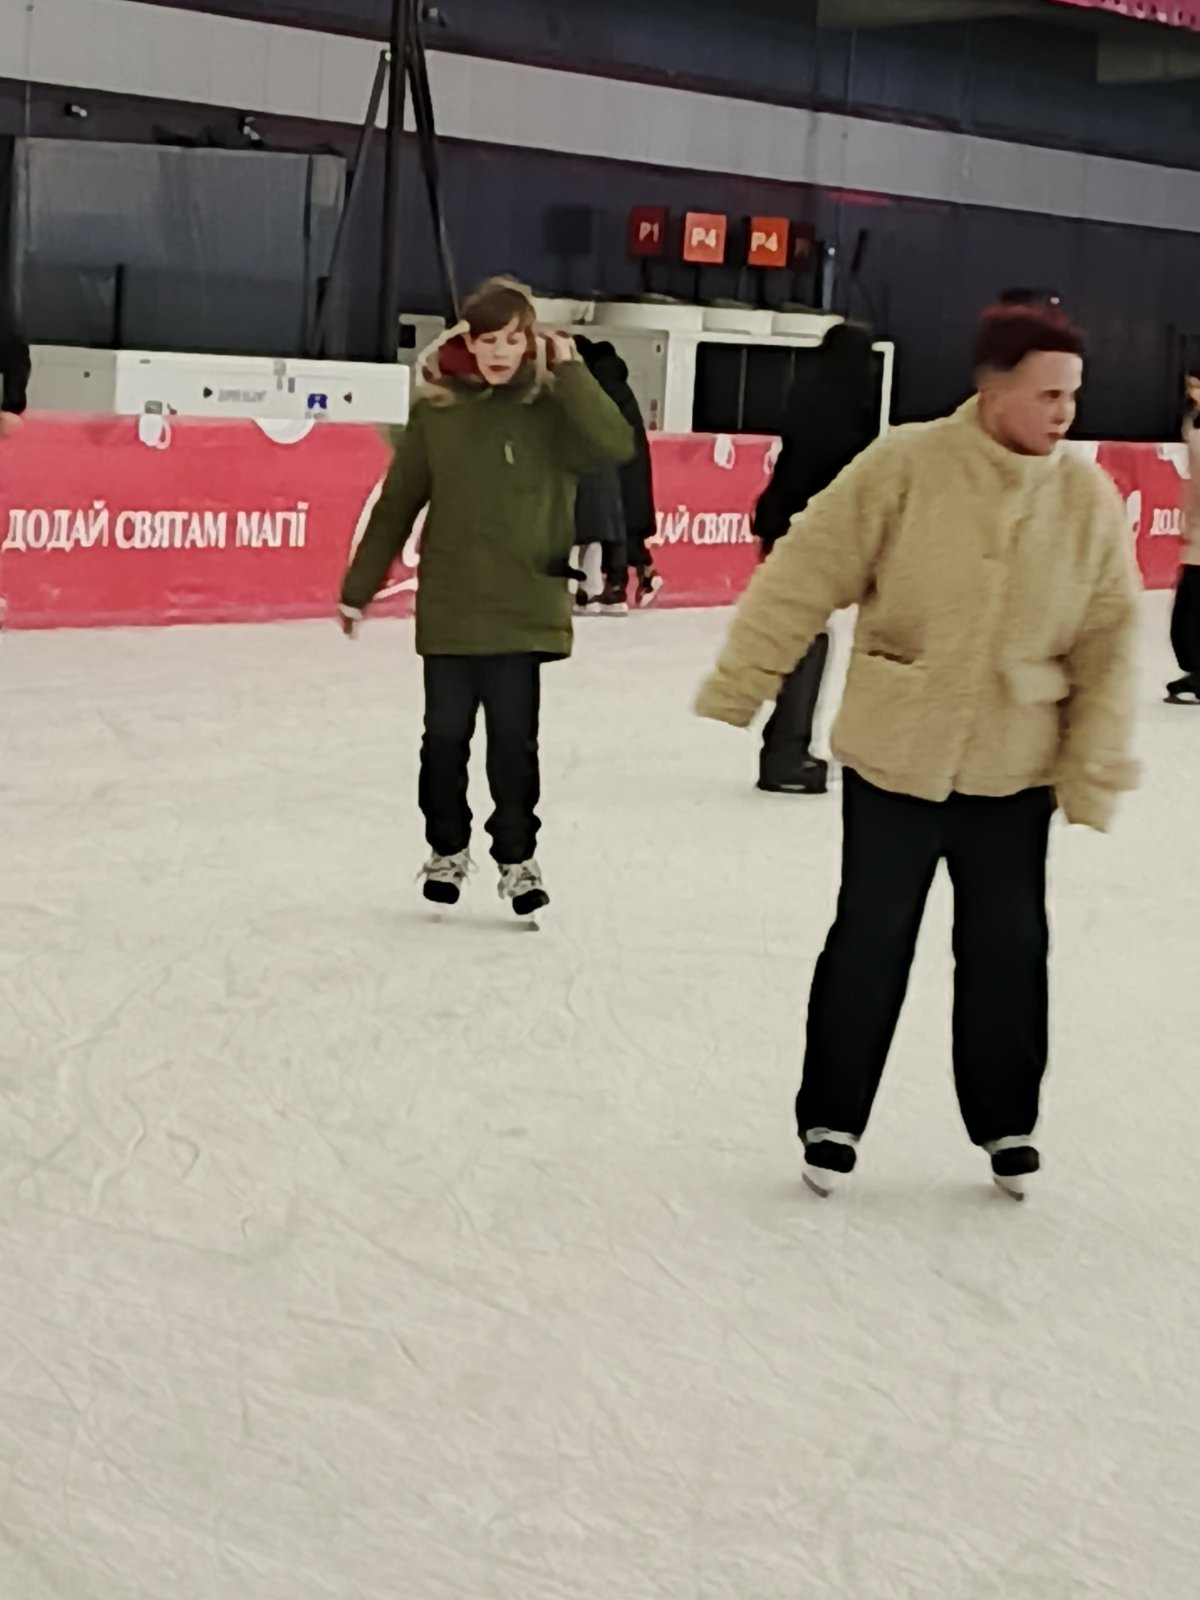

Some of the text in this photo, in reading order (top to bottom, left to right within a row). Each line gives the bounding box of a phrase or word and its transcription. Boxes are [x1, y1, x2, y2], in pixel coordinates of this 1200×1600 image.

[639, 221, 659, 242] P1
[691, 227, 717, 248] P4
[751, 231, 778, 252] P4
[3, 501, 309, 551] ДОДАЙ СВЯТАМ МАГІЇ
[692, 512, 756, 545] СВЯТА
